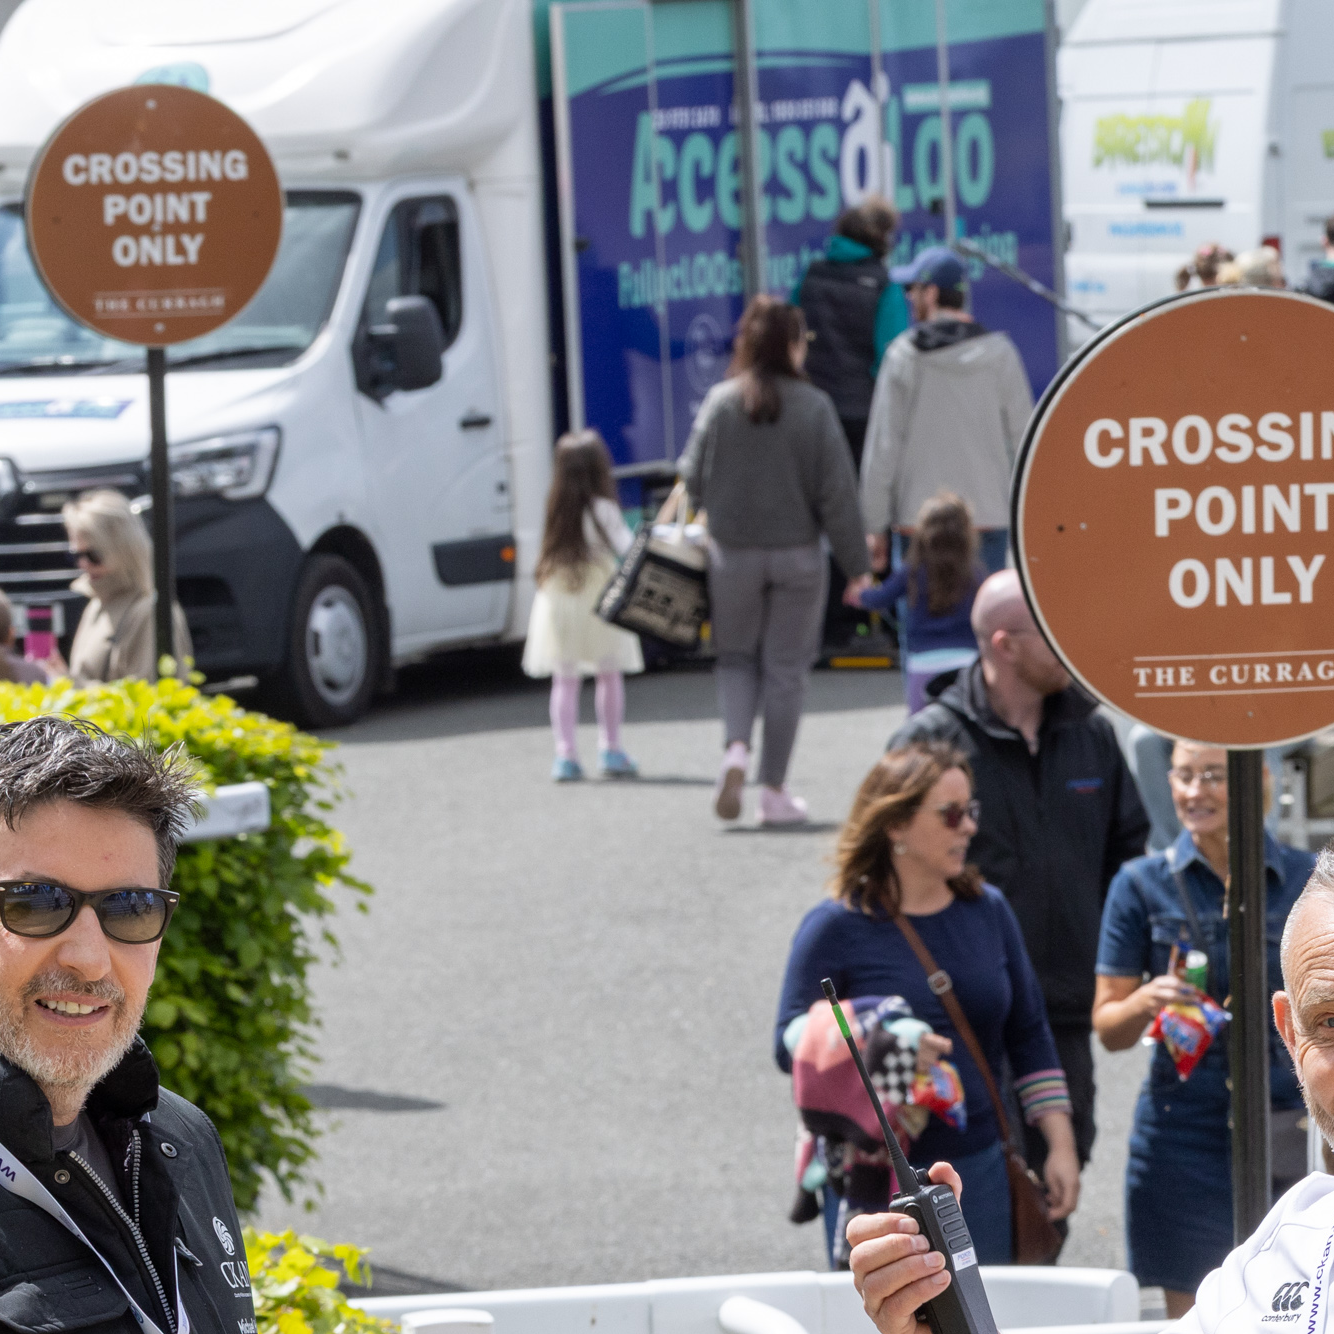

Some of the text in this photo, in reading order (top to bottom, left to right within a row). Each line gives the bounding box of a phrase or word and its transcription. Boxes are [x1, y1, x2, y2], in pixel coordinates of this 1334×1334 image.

[63, 151, 248, 186] CROSSING
[103, 191, 212, 225] POINT
[112, 233, 205, 267] ONLY
[1168, 554, 1326, 608] ONLY
[1133, 667, 1195, 687] THE
[1261, 1312, 1301, 1323] canterbury
